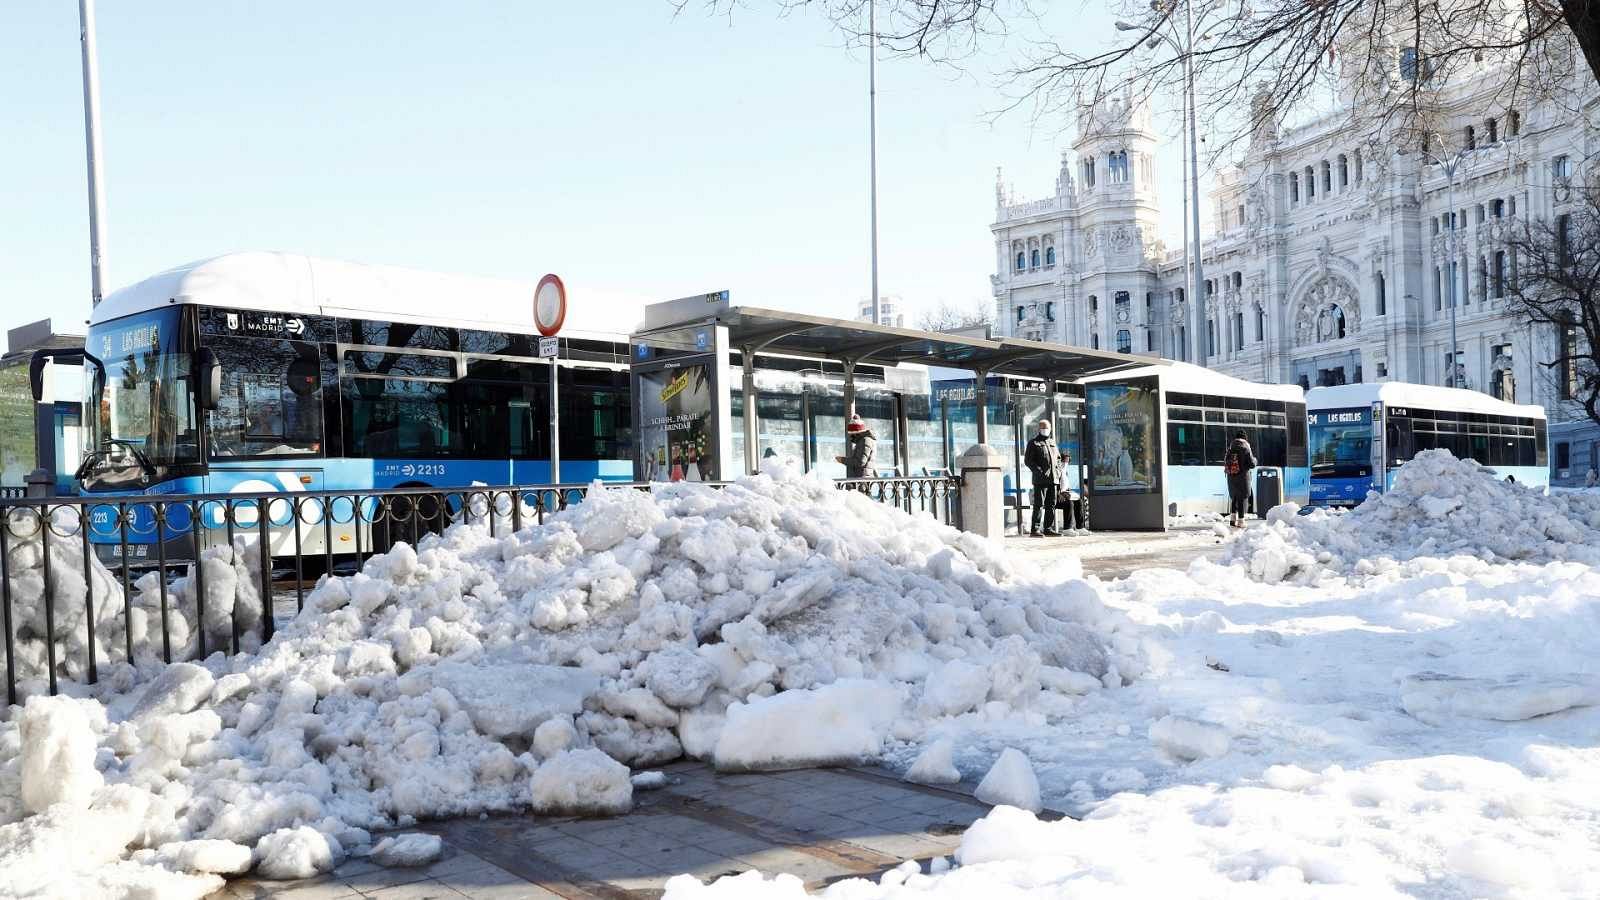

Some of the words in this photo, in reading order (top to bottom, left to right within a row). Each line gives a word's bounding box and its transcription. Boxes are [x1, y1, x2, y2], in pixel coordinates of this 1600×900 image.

[264, 317, 282, 325] EMT
[247, 323, 283, 332] MADRID
[1308, 414, 1317, 424] 34
[1328, 413, 1338, 423] LAS
[418, 464, 445, 475] 2213
[94, 512, 108, 523] 2213
